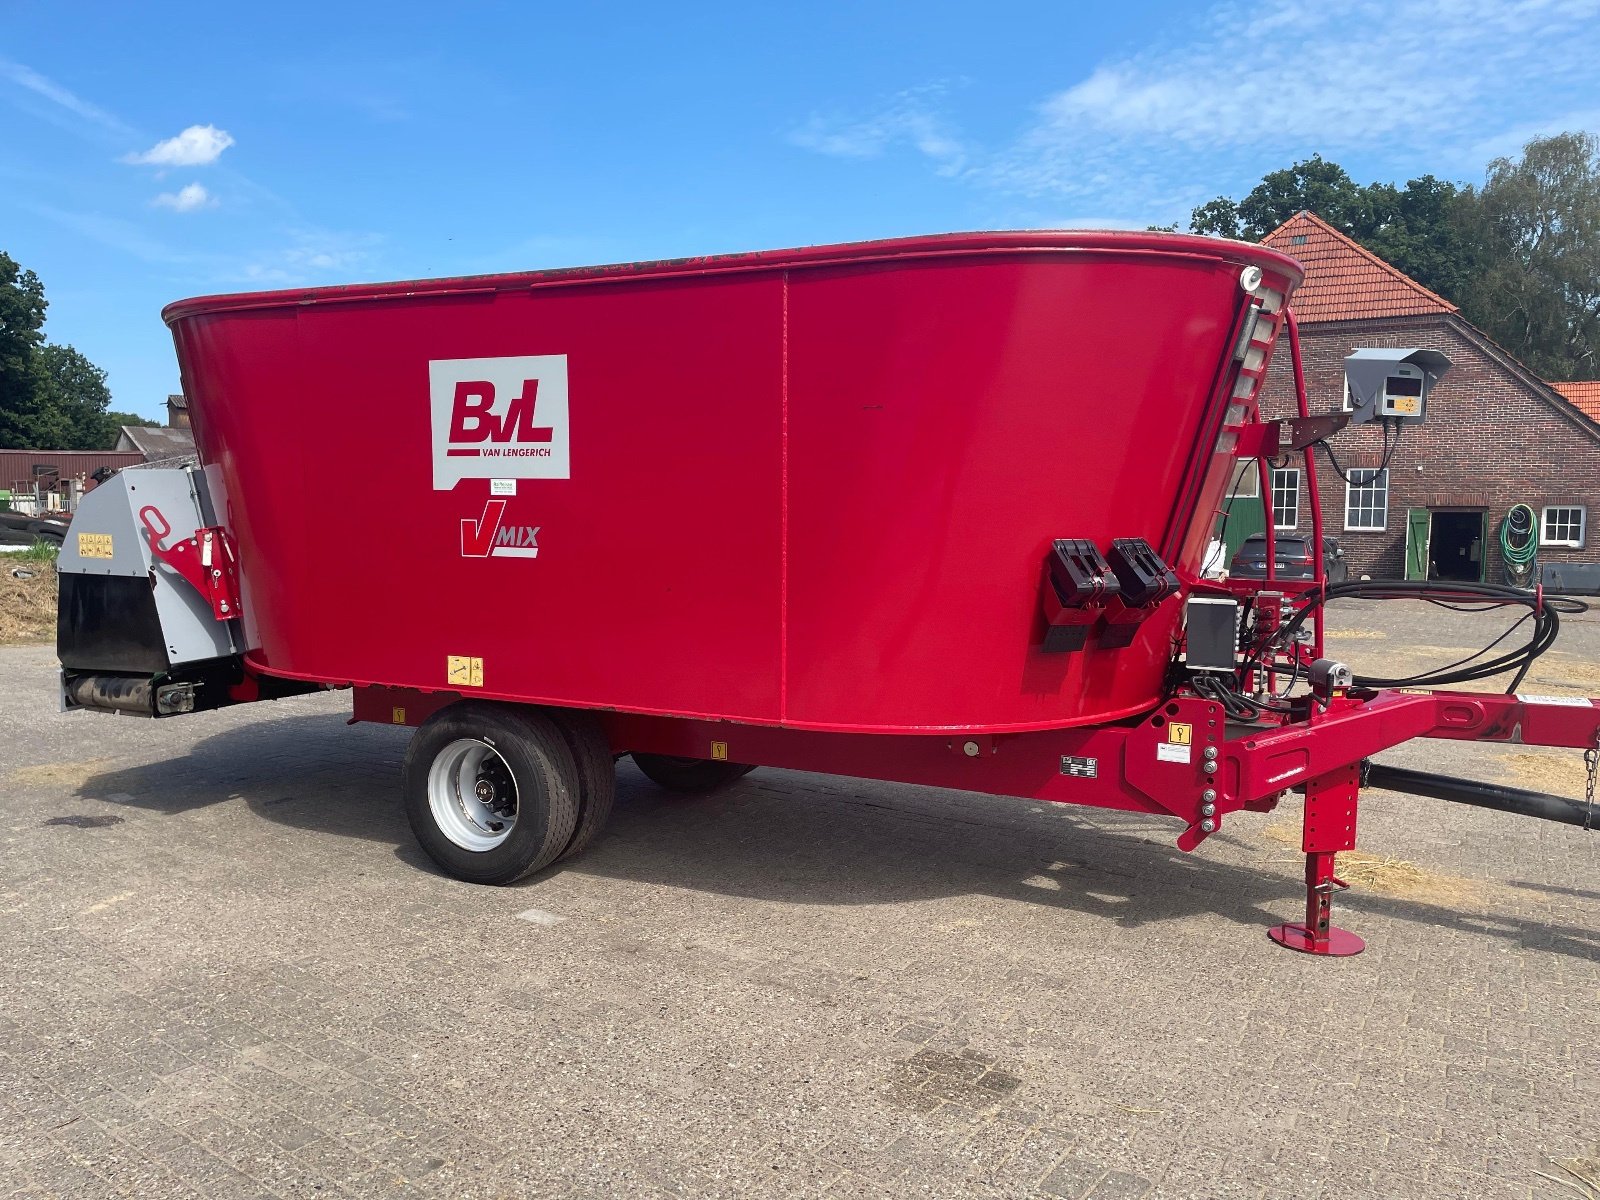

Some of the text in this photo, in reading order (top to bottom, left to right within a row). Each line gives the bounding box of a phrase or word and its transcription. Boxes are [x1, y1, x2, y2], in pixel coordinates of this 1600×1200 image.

[482, 448, 551, 457] VAN LENGERICH
[495, 526, 540, 547] MIX
